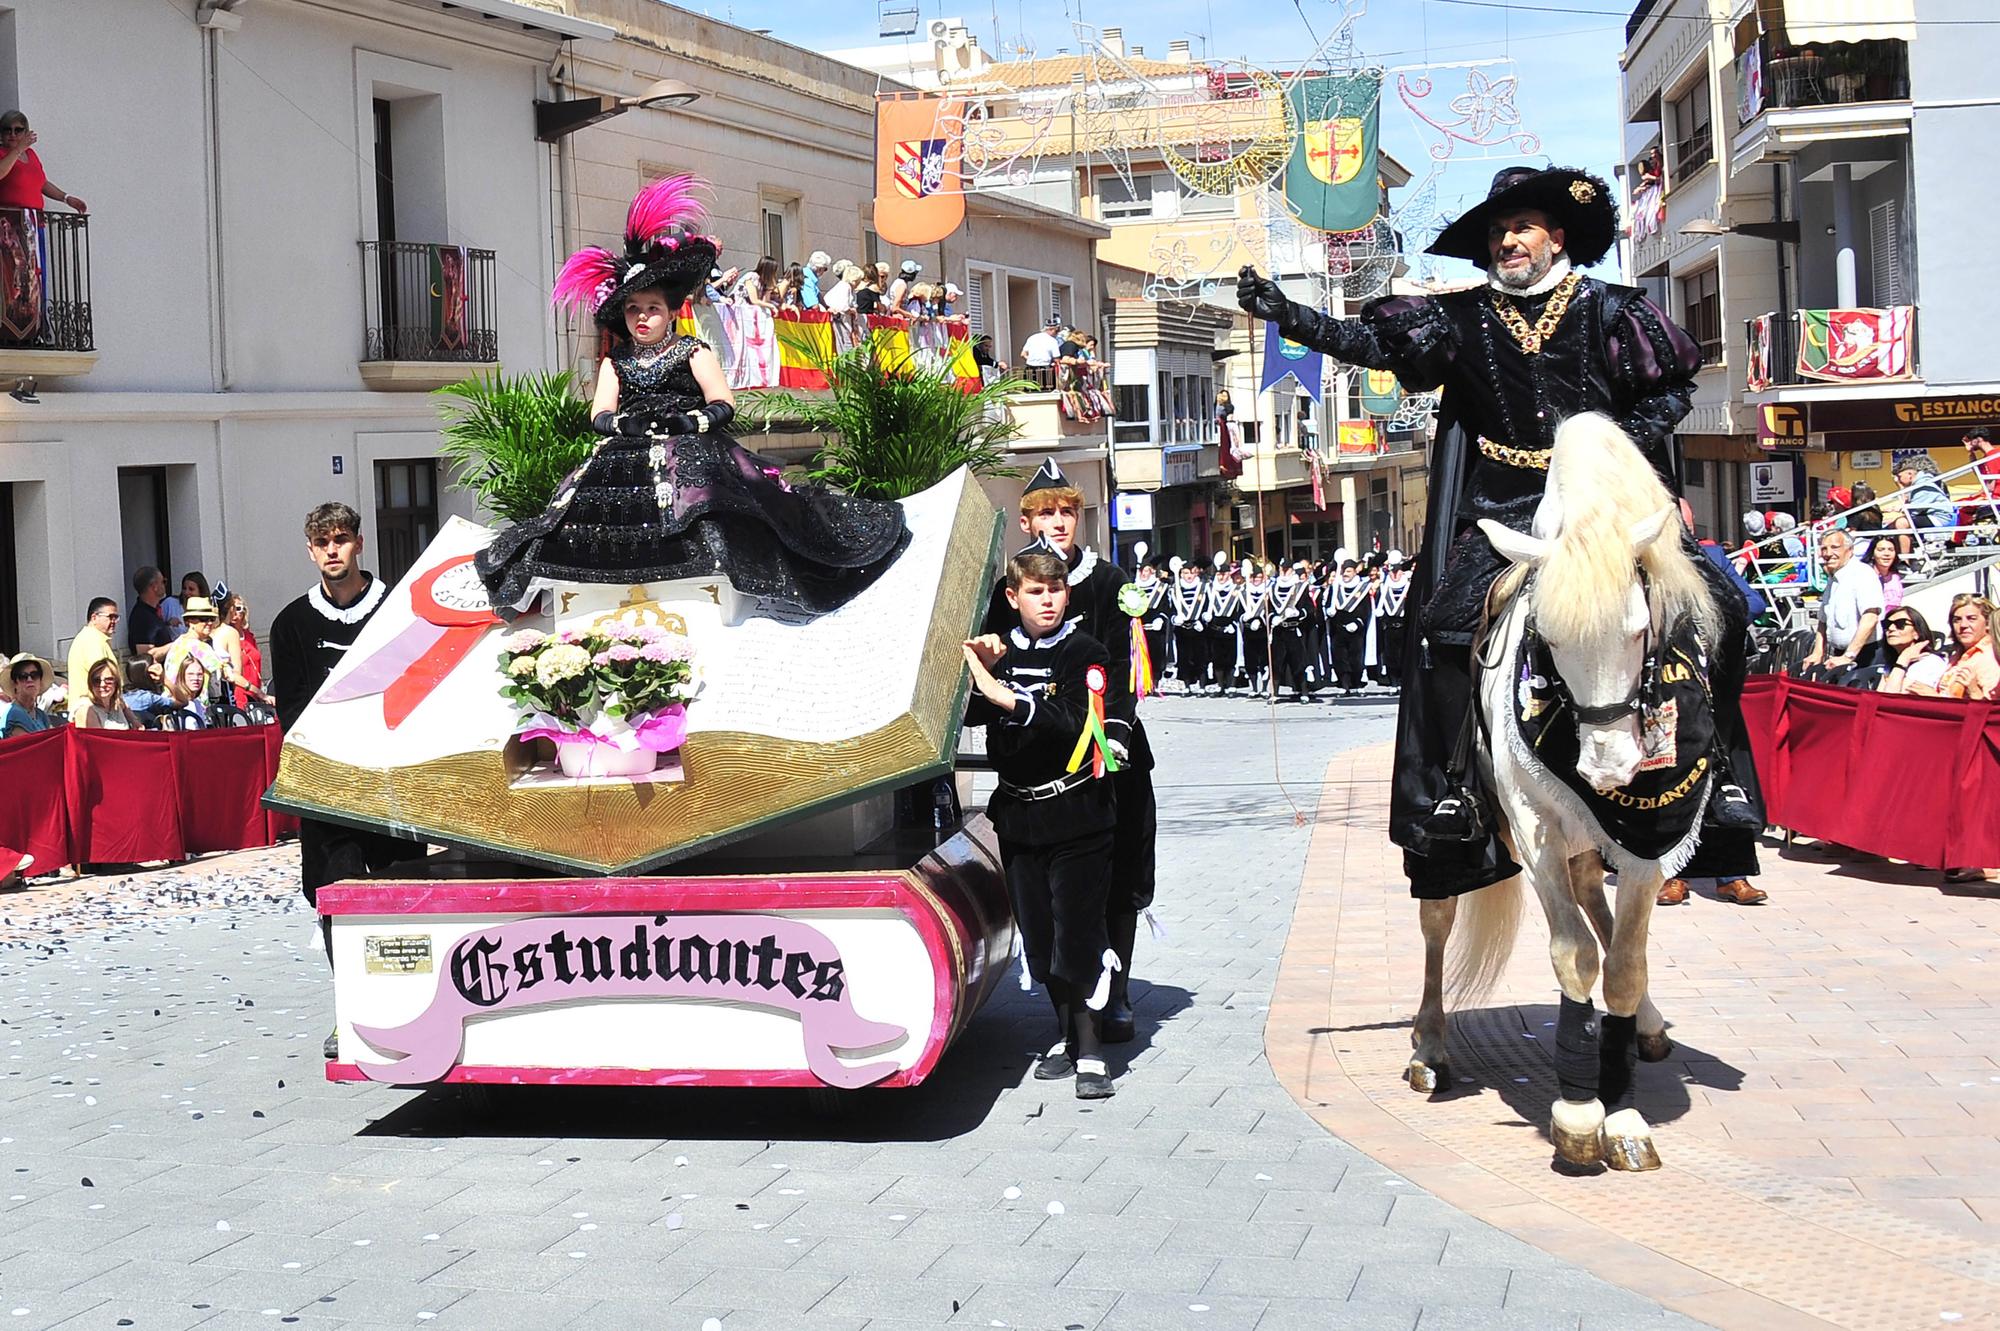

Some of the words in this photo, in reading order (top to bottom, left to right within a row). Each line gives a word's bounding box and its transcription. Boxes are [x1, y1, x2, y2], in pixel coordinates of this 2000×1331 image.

[1763, 438, 1804, 446] ESTANCO
[435, 590, 487, 608] ESTUD
[1595, 757, 1708, 810] STUDIANTES
[450, 915, 845, 1006] Estudiantes
